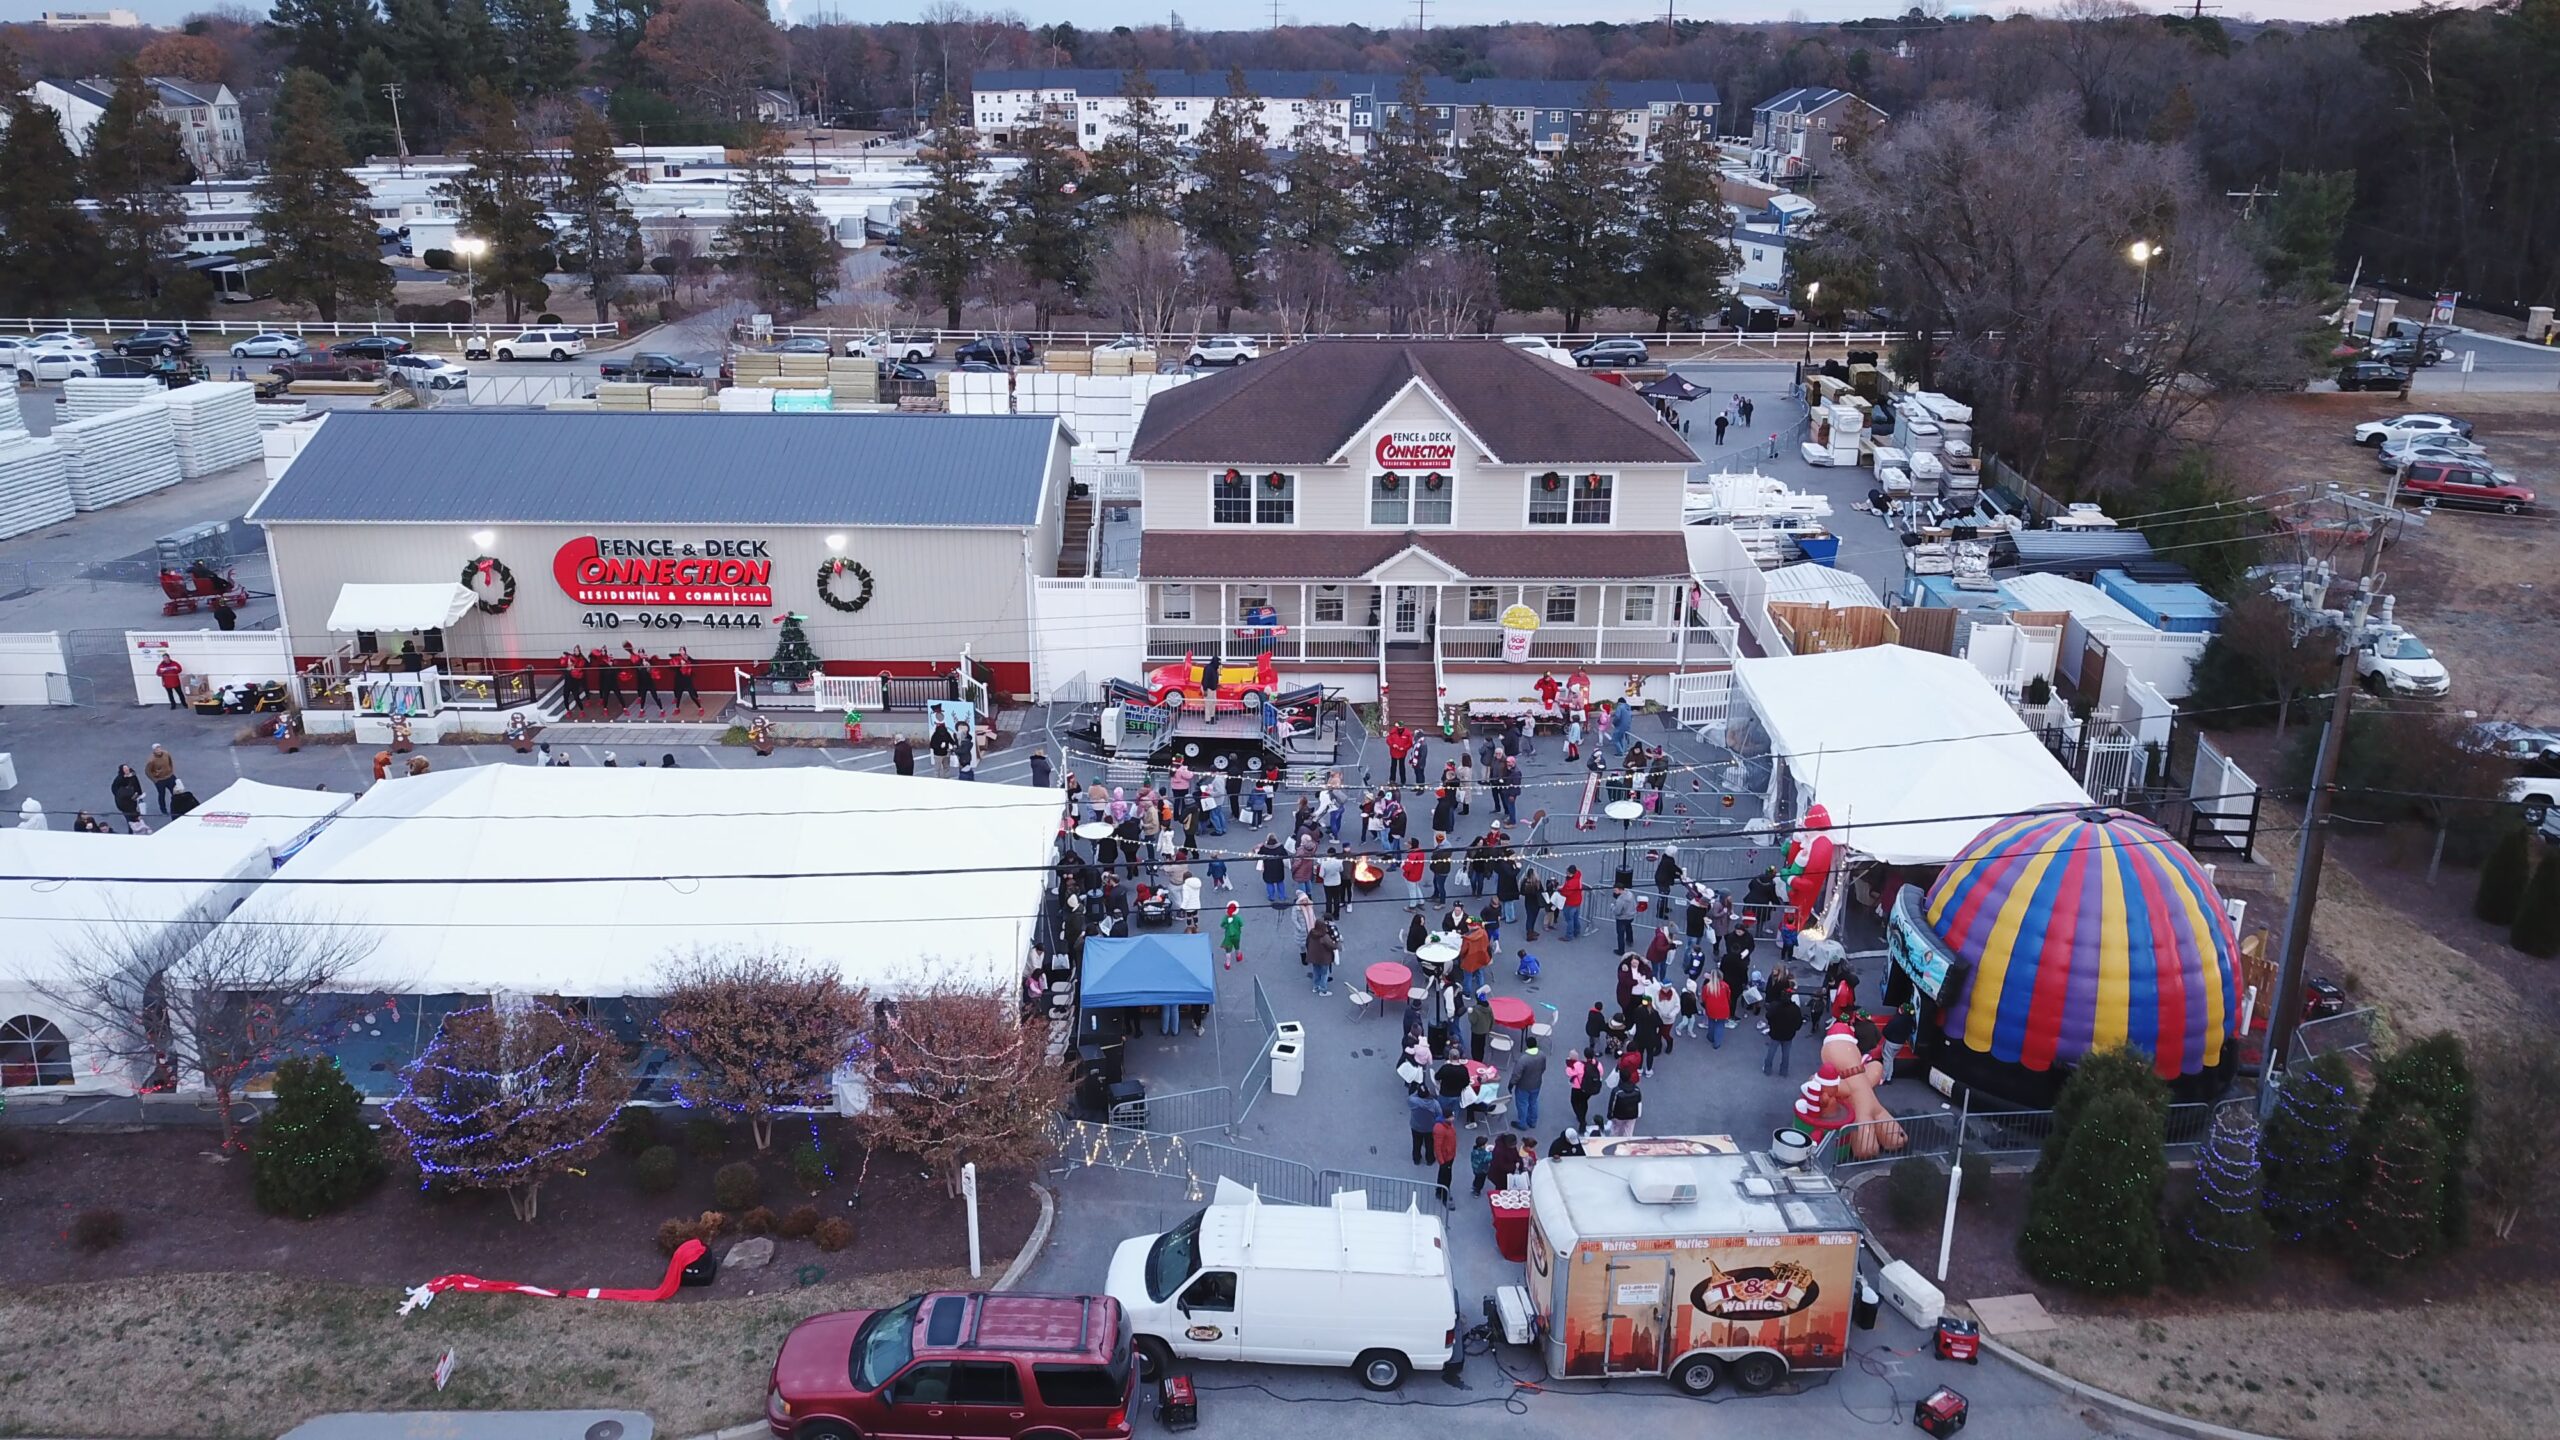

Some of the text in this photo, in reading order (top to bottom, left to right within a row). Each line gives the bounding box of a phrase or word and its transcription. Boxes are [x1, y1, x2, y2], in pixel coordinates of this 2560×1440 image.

[1393, 432, 1419, 442] FENCE
[1428, 432, 1452, 442] DECK
[1375, 434, 1456, 461] CONNECTION
[599, 539, 771, 558] FENCE & DECK
[553, 535, 773, 588] CONNECTION
[578, 590, 769, 602] RESIDENTIAL & COMMERCIAL
[582, 612, 762, 630] 410-969-4444
[1674, 1238, 1710, 1249] Waffles
[1746, 1236, 1781, 1247] Waffles
[1819, 1234, 1853, 1245] Waffles
[1602, 1241, 1638, 1252] Waffles
[1712, 1277, 1794, 1300] T & J
[1722, 1299, 1784, 1313] Waffles
